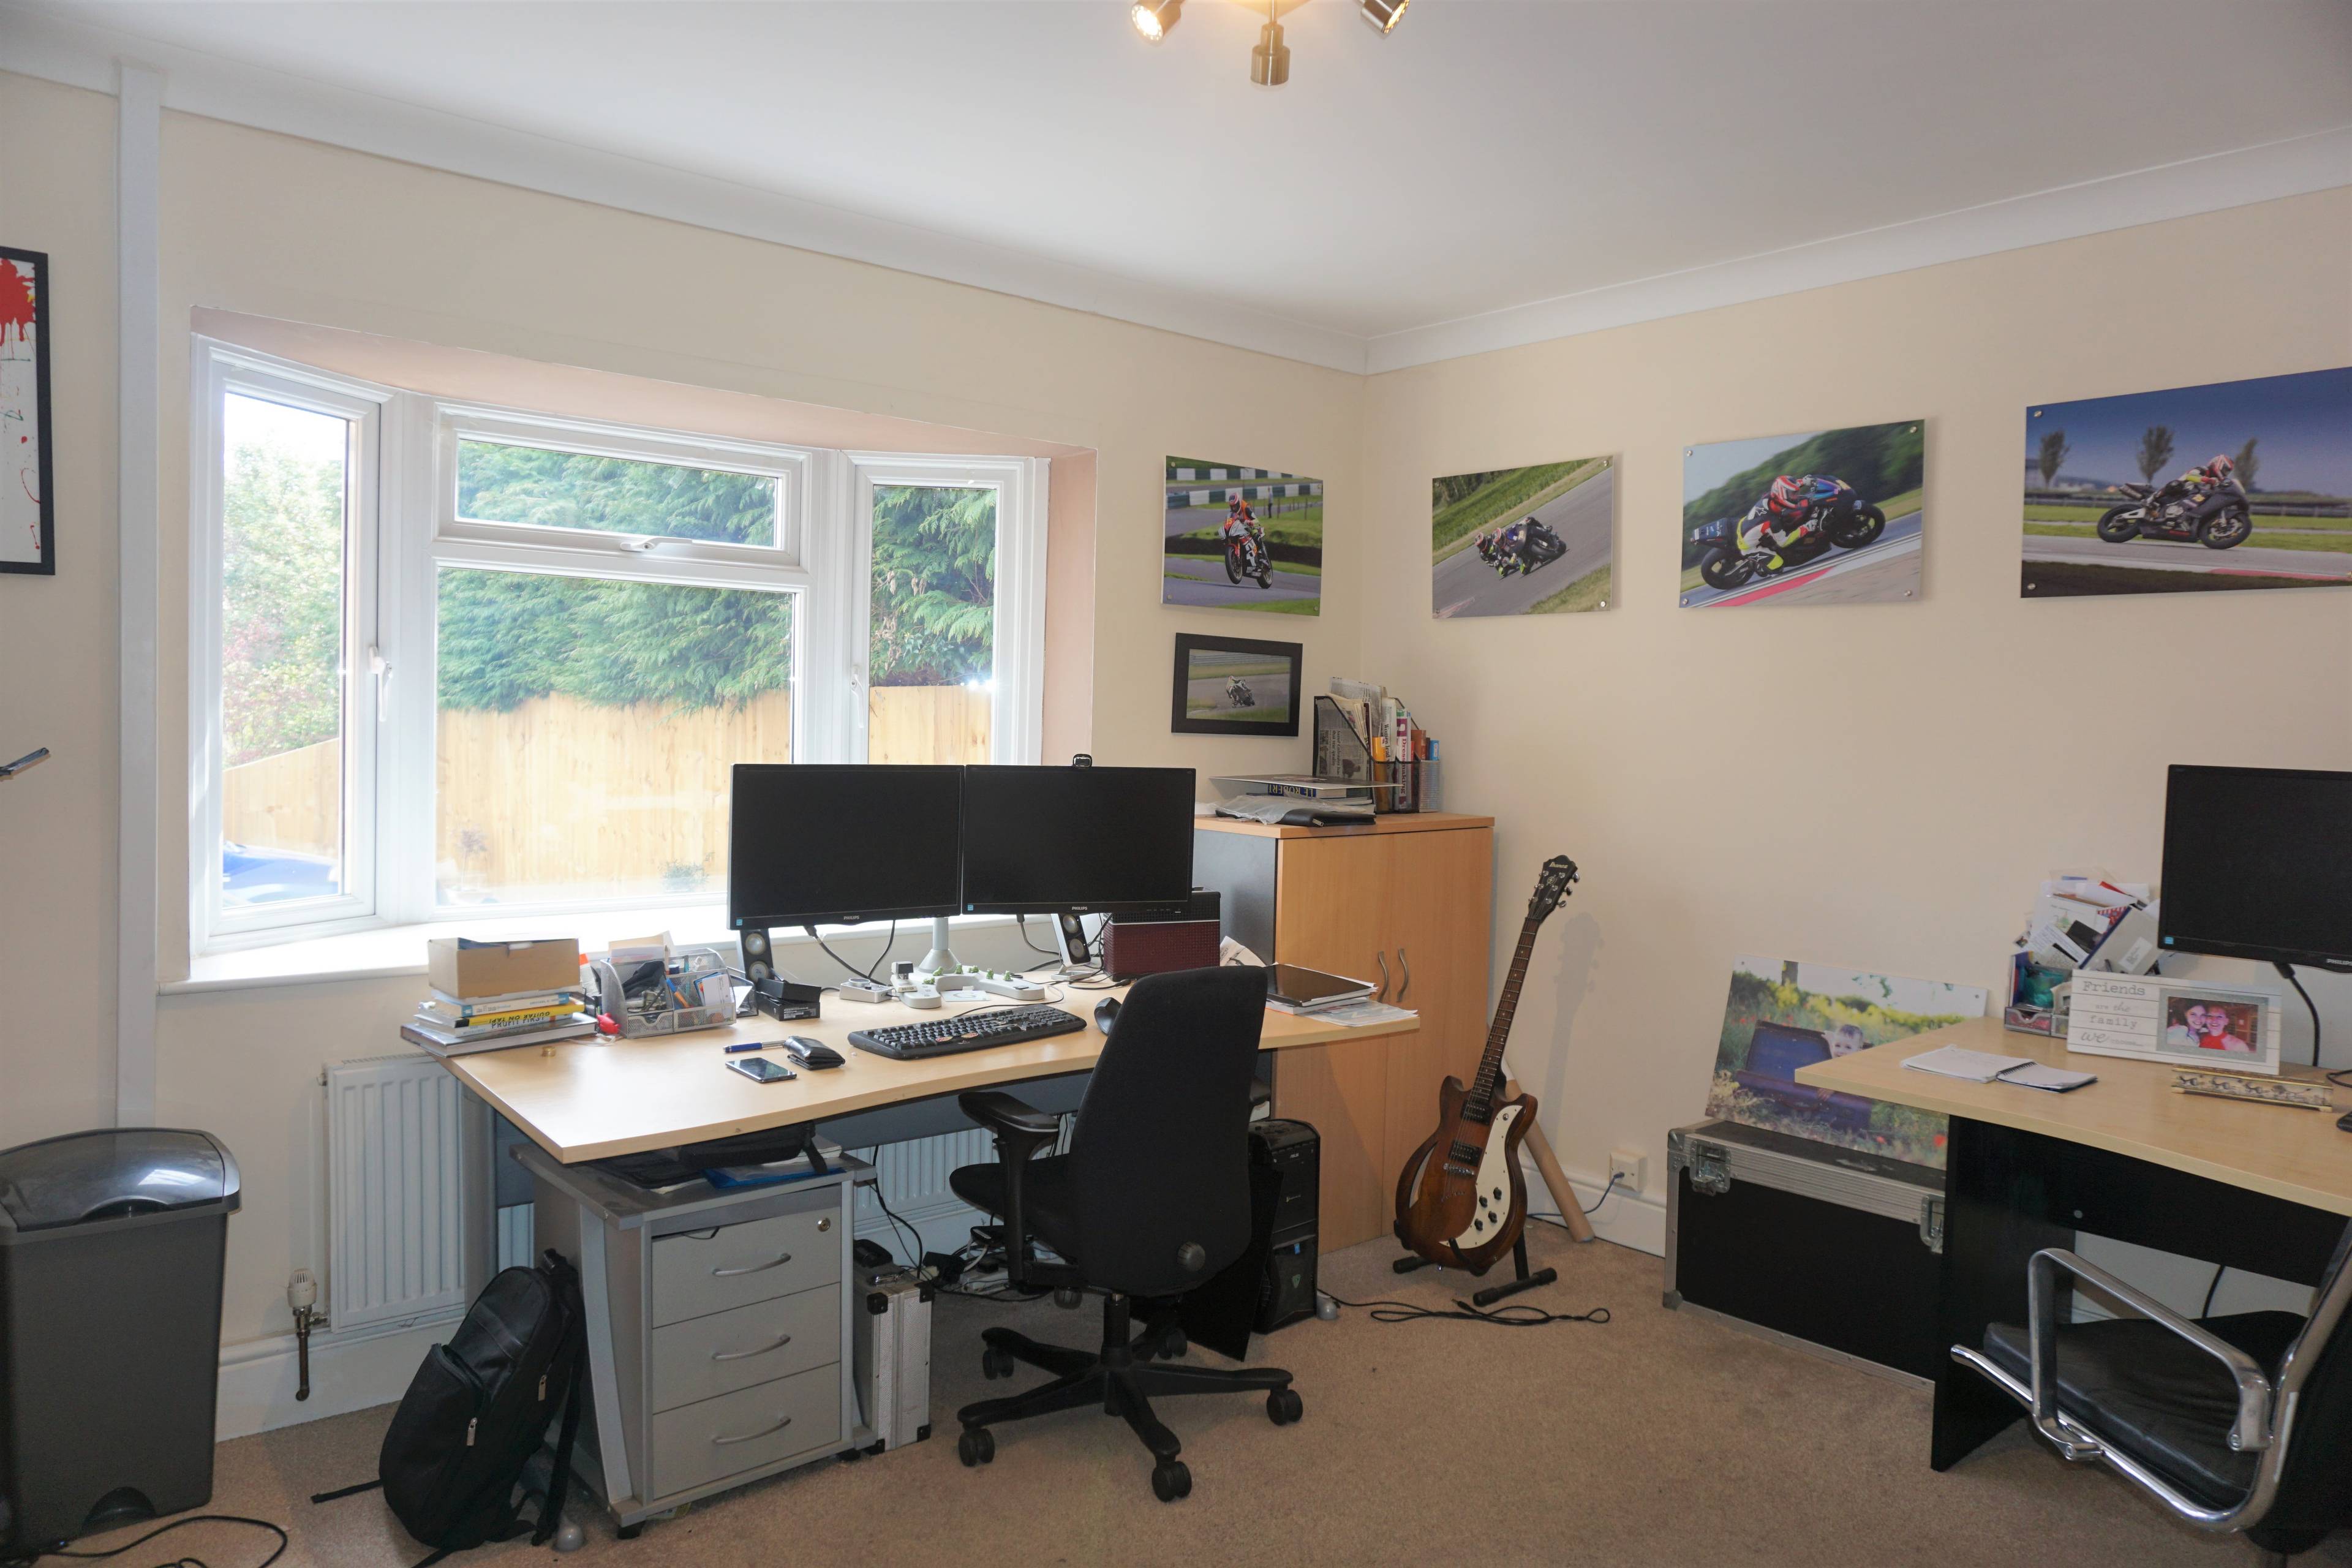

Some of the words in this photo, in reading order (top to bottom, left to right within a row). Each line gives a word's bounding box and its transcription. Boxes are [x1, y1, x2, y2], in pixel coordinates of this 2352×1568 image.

[2082, 981, 2146, 996] Friends
[2113, 1001, 2130, 1012] the
[524, 1011, 551, 1020] GUITAR
[2089, 1015, 2138, 1030] family
[2081, 1031, 2109, 1043] we
